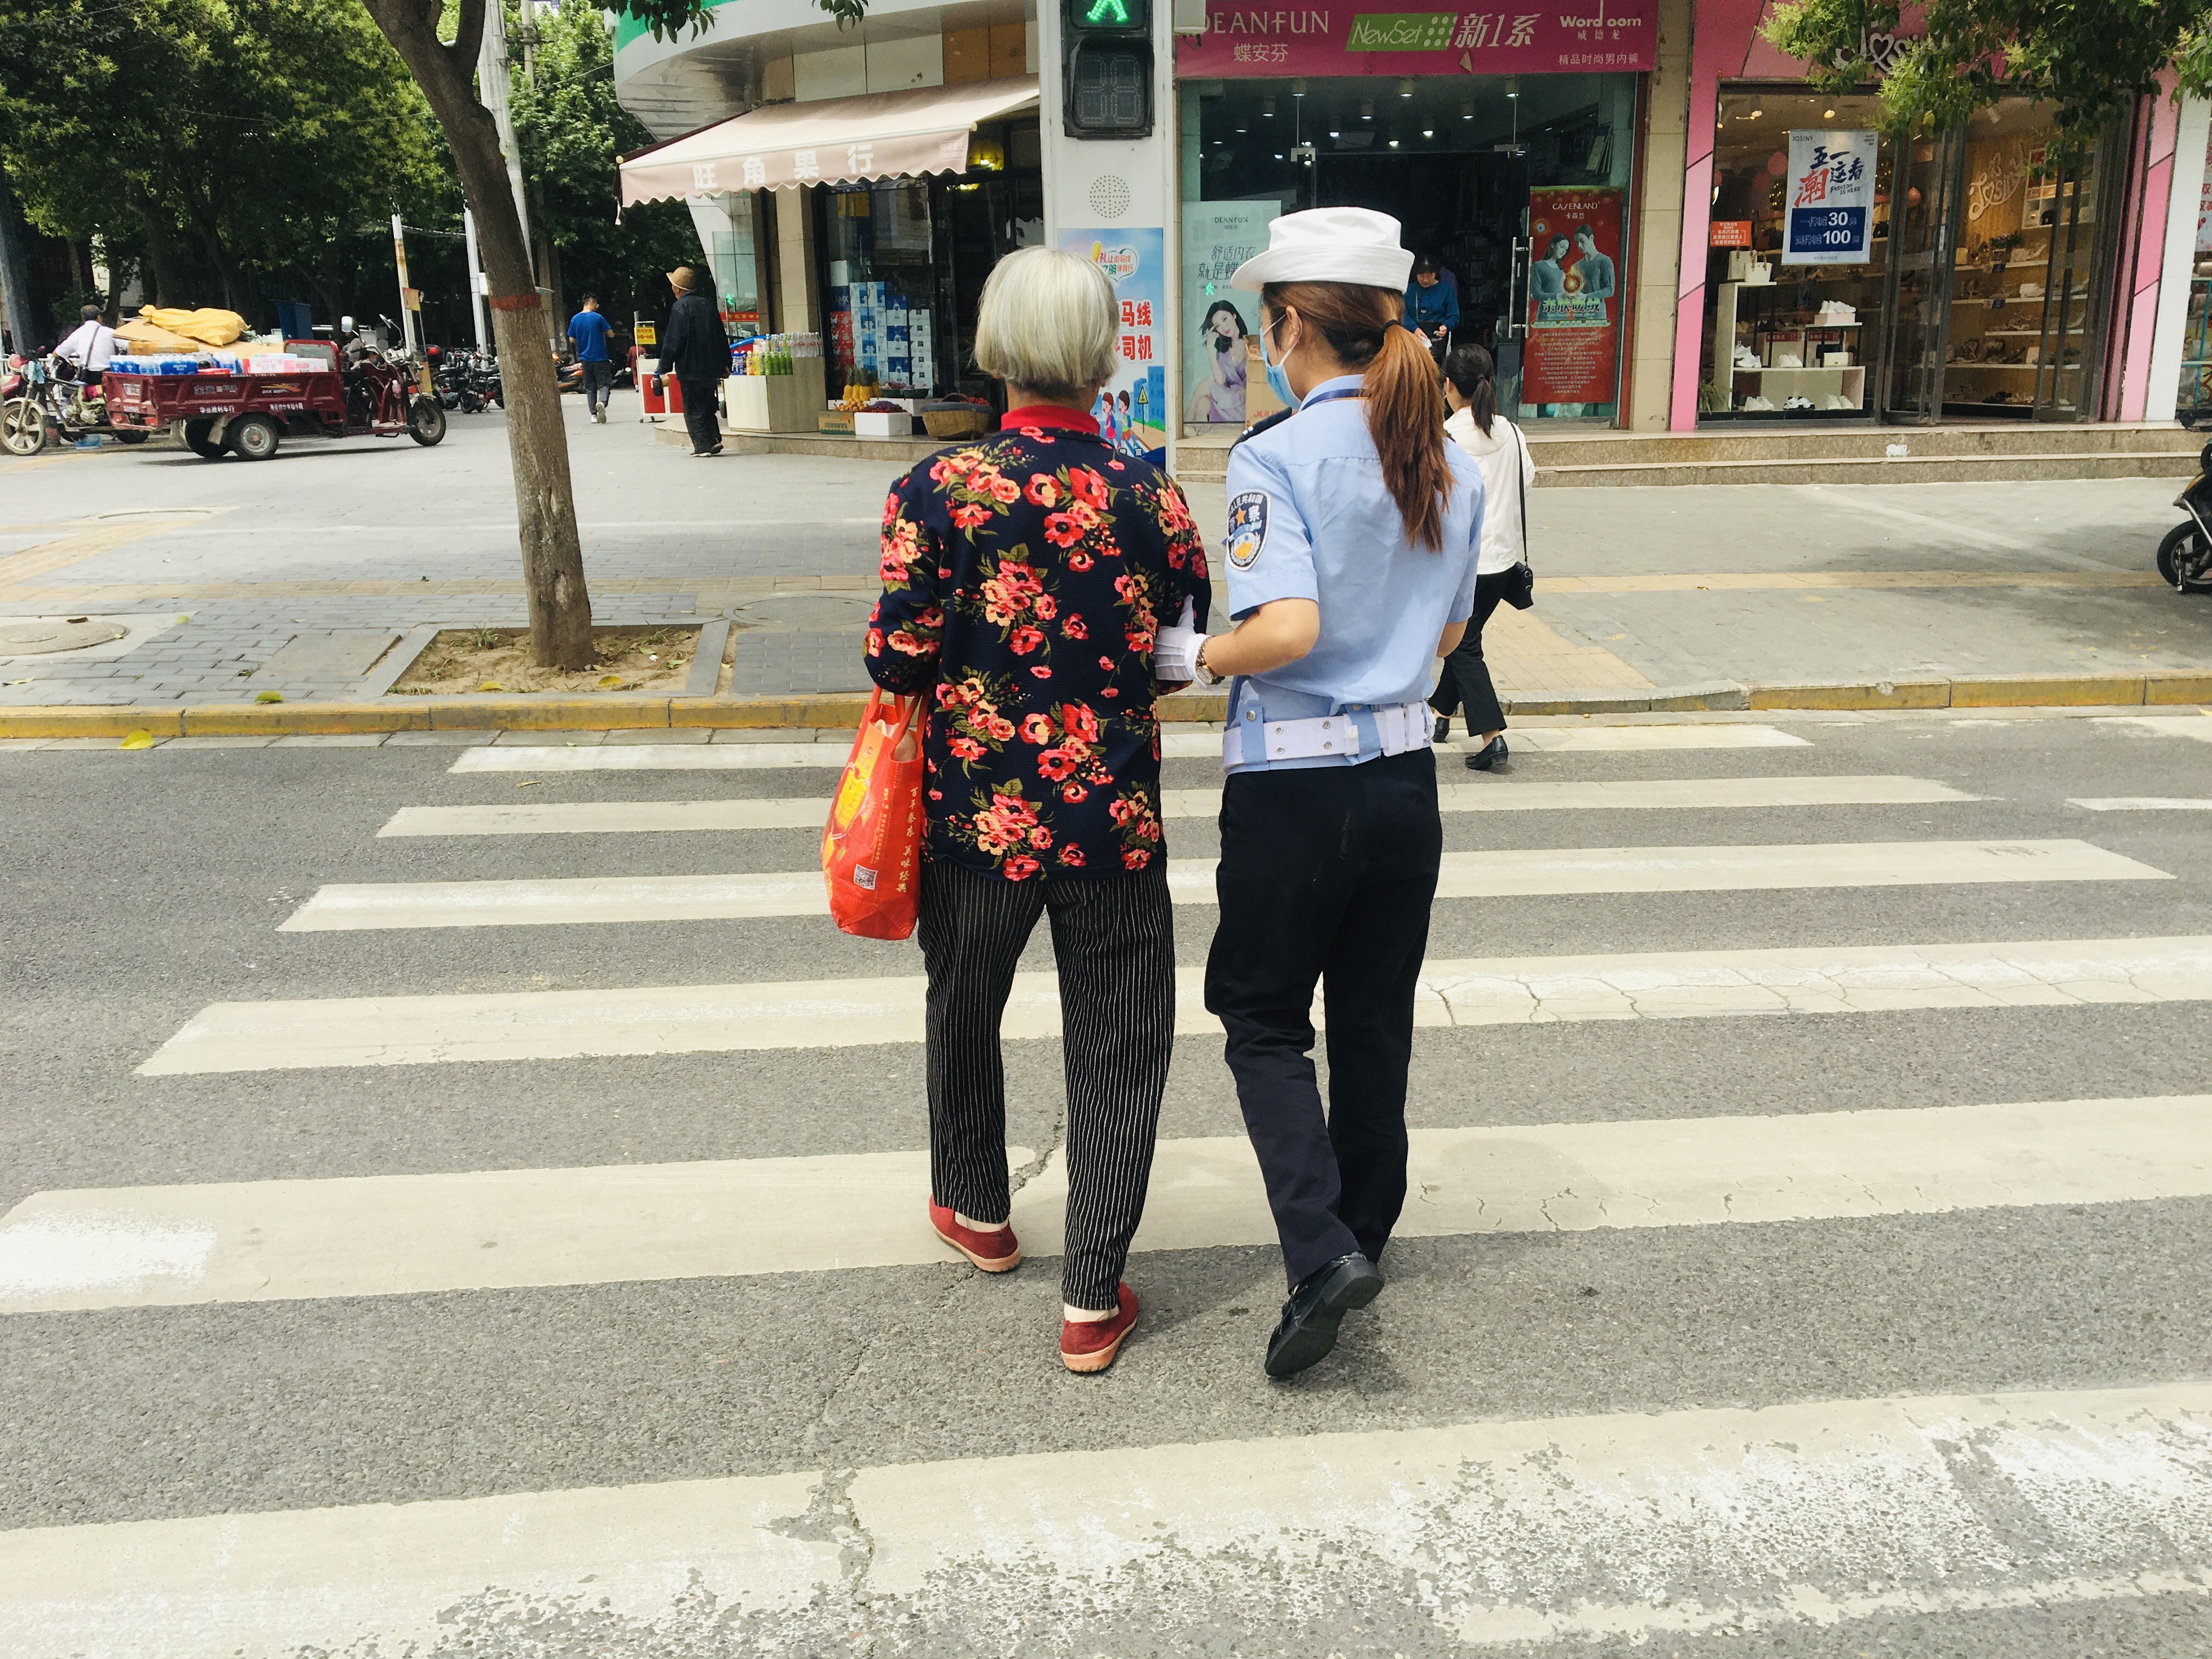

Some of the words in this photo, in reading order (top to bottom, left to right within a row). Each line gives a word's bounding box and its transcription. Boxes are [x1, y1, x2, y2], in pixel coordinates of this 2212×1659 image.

[1351, 20, 1423, 45] NewSet
[1577, 29, 1620, 41] 威德龙
[1234, 43, 1288, 63] 蝶安芬
[1558, 53, 1639, 66] 精品时尚男内裤
[1810, 146, 1850, 170] 五一
[692, 144, 874, 190] 旺角果行
[1794, 168, 1830, 208] 潮
[1830, 183, 1854, 193] FASHION
[1828, 211, 1849, 227] 30
[1822, 229, 1852, 245] 100
[1211, 245, 1256, 261] 舒适内衣
